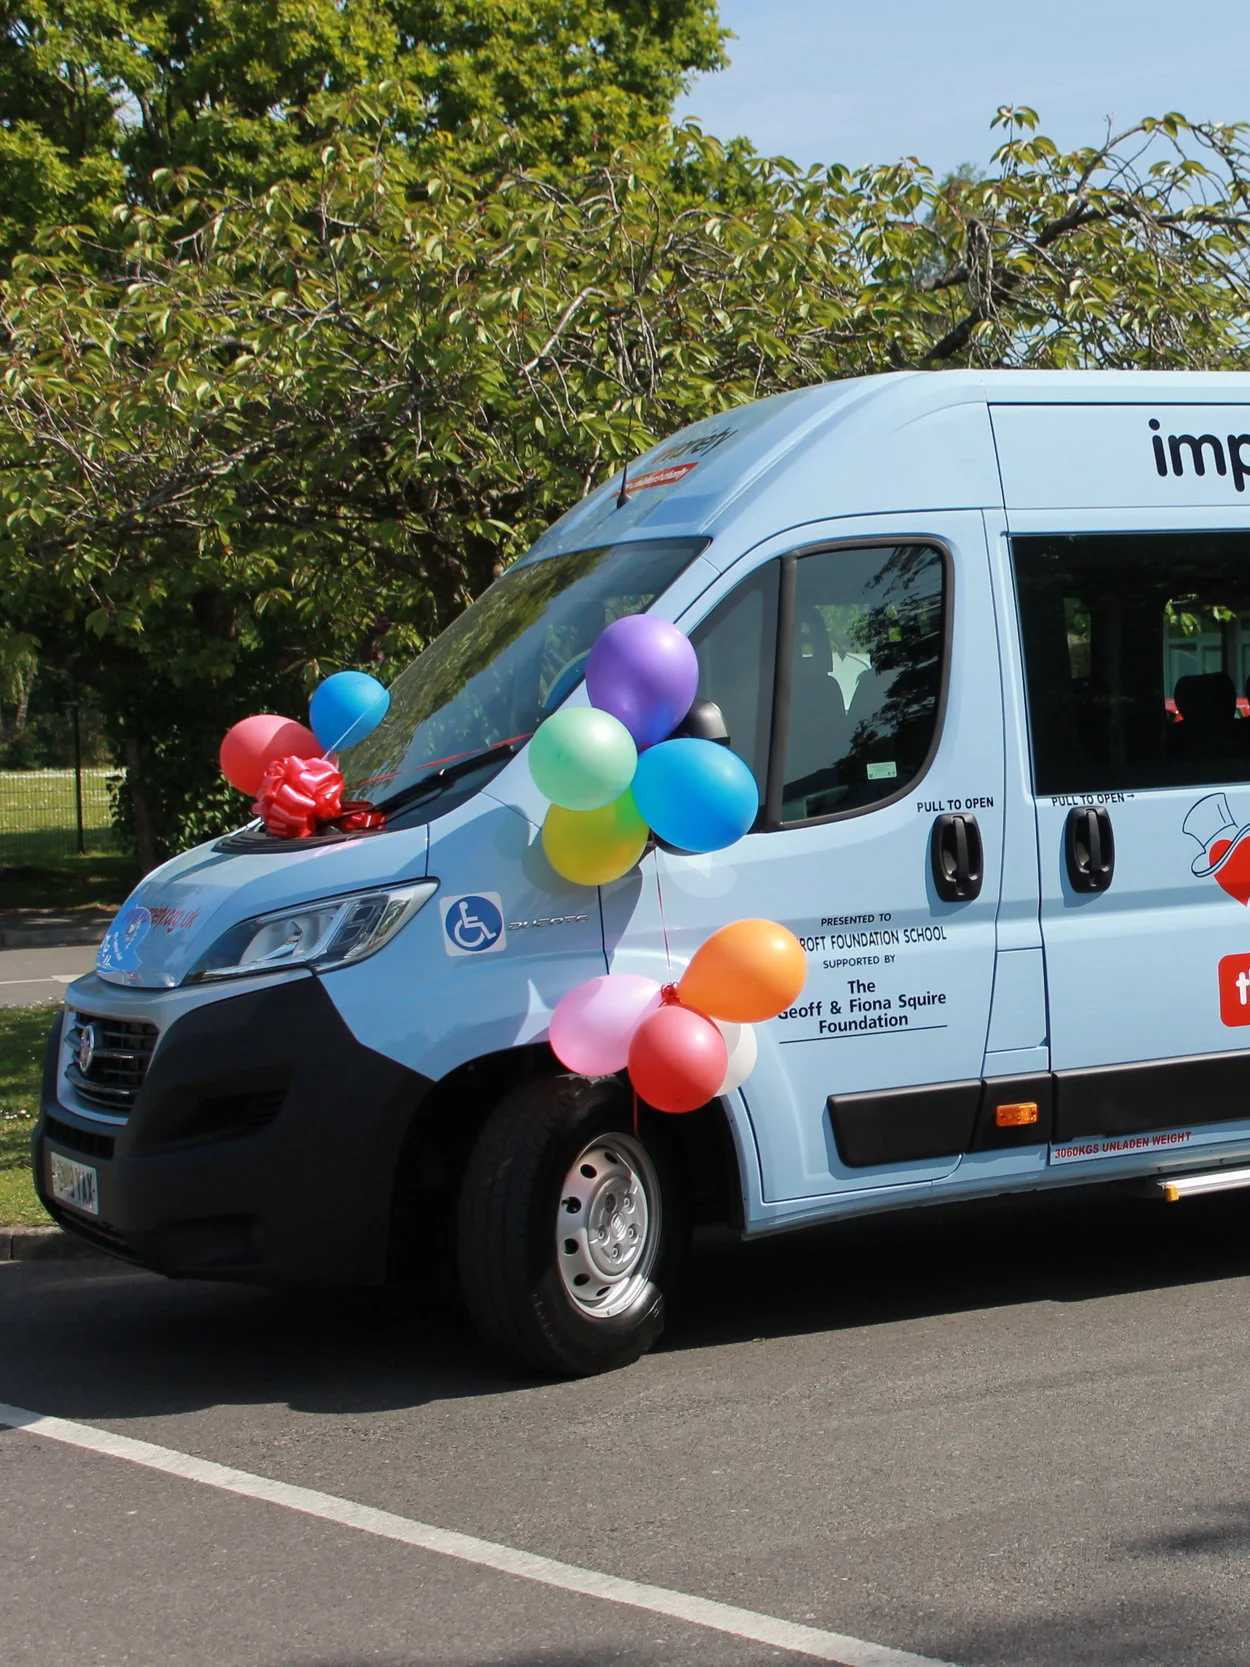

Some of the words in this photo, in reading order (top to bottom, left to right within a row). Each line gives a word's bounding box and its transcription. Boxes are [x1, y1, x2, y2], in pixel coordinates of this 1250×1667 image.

[917, 800, 945, 813] PULL
[947, 799, 962, 810] TO
[965, 797, 994, 809] OPEN
[1051, 796, 1079, 807] PULL
[1080, 794, 1094, 805] TO
[1097, 792, 1125, 804] OPEN
[821, 914, 875, 927] PRESENTED
[879, 912, 892, 922] TO
[796, 936, 827, 952] ROFT
[831, 930, 900, 950] FOUNDATION
[904, 925, 947, 944] SCHOOL
[823, 955, 880, 969] SUPPORTED
[884, 954, 896, 964] BY
[847, 979, 876, 994] The
[778, 1001, 823, 1020] Geoff
[830, 1001, 842, 1015] &
[849, 998, 892, 1013] Fiona
[898, 991, 947, 1010] Squire
[819, 1013, 909, 1034] Foundation
[1055, 1144, 1099, 1159] 3060KGS
[1102, 1137, 1149, 1153] UNLADEN
[1152, 1131, 1192, 1146] WEIGHT
